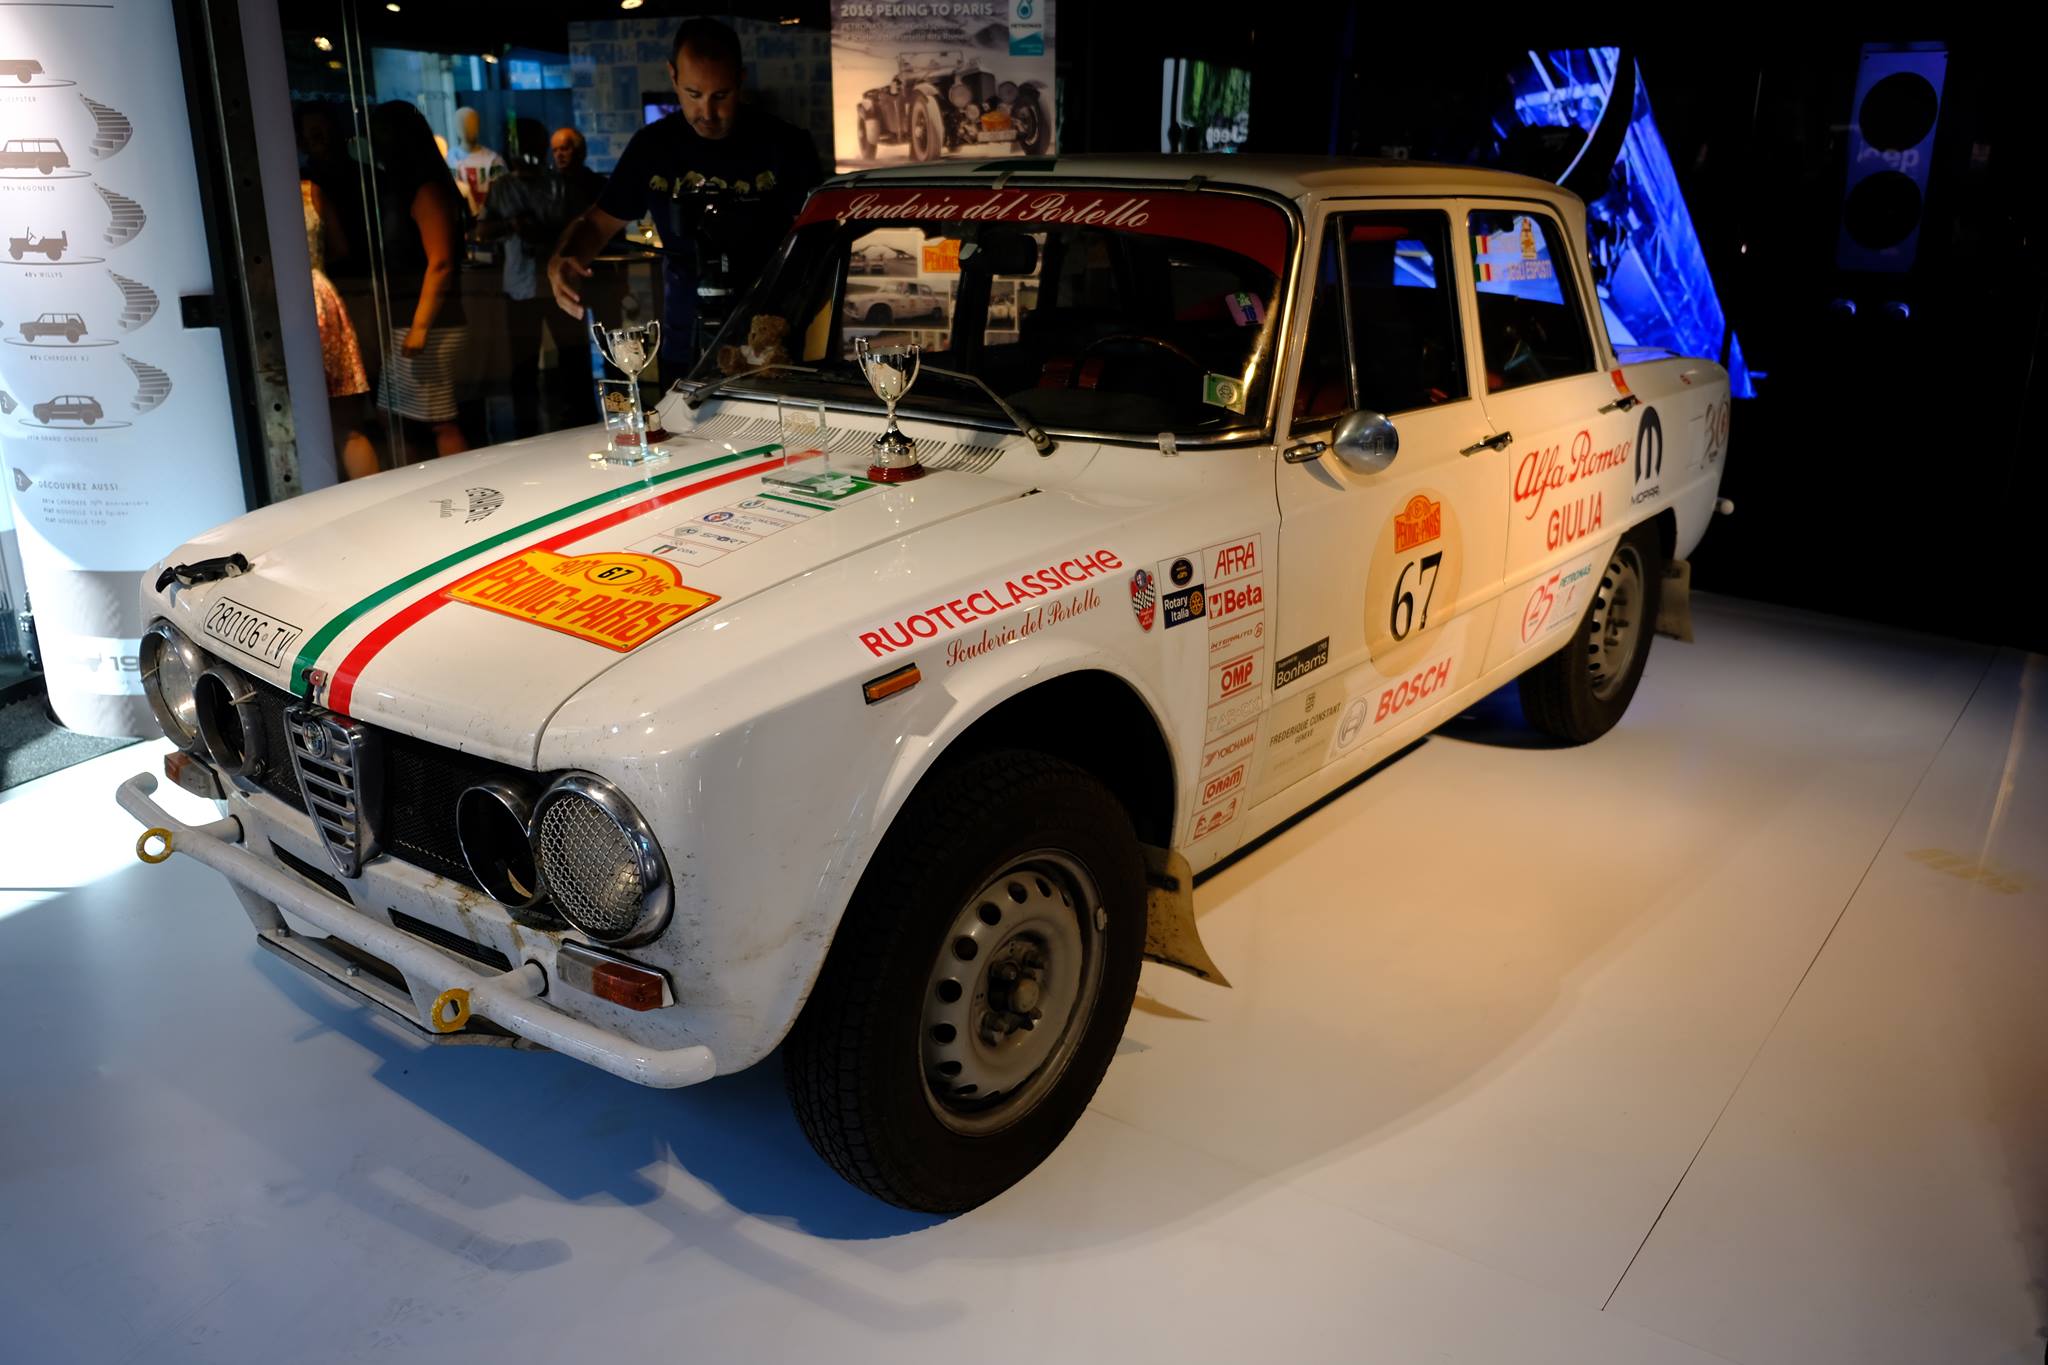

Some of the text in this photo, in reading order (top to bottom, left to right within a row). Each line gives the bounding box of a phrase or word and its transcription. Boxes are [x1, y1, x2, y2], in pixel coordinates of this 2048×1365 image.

[841, 3, 993, 17] 2016 PEKING TO PARIS
[836, 193, 1149, 228] Scuderia del Portello
[91, 482, 119, 491] AUSSI
[1513, 429, 1633, 521] Alfa Romeo
[1546, 491, 1602, 551] GIULIA
[597, 565, 635, 581] 67
[1214, 541, 1257, 579] AFRA
[457, 557, 582, 615] PEKING
[561, 594, 694, 643] PARIS
[1164, 594, 1189, 611] Rotary
[1171, 607, 1190, 623] Italia
[1224, 583, 1263, 614] Beta
[1390, 550, 1443, 642] 67
[206, 602, 297, 661] 280106 TV
[946, 627, 1016, 667] Scuderia
[1021, 612, 1043, 637] del
[1047, 588, 1101, 626] Portello
[1221, 661, 1253, 691] OMP
[1276, 650, 1327, 688] Bonhams
[1374, 657, 1452, 725] BOSCH
[1269, 702, 1342, 749] FREDERIQUE CONSTANT
[1217, 733, 1254, 760] YOKOHAMA
